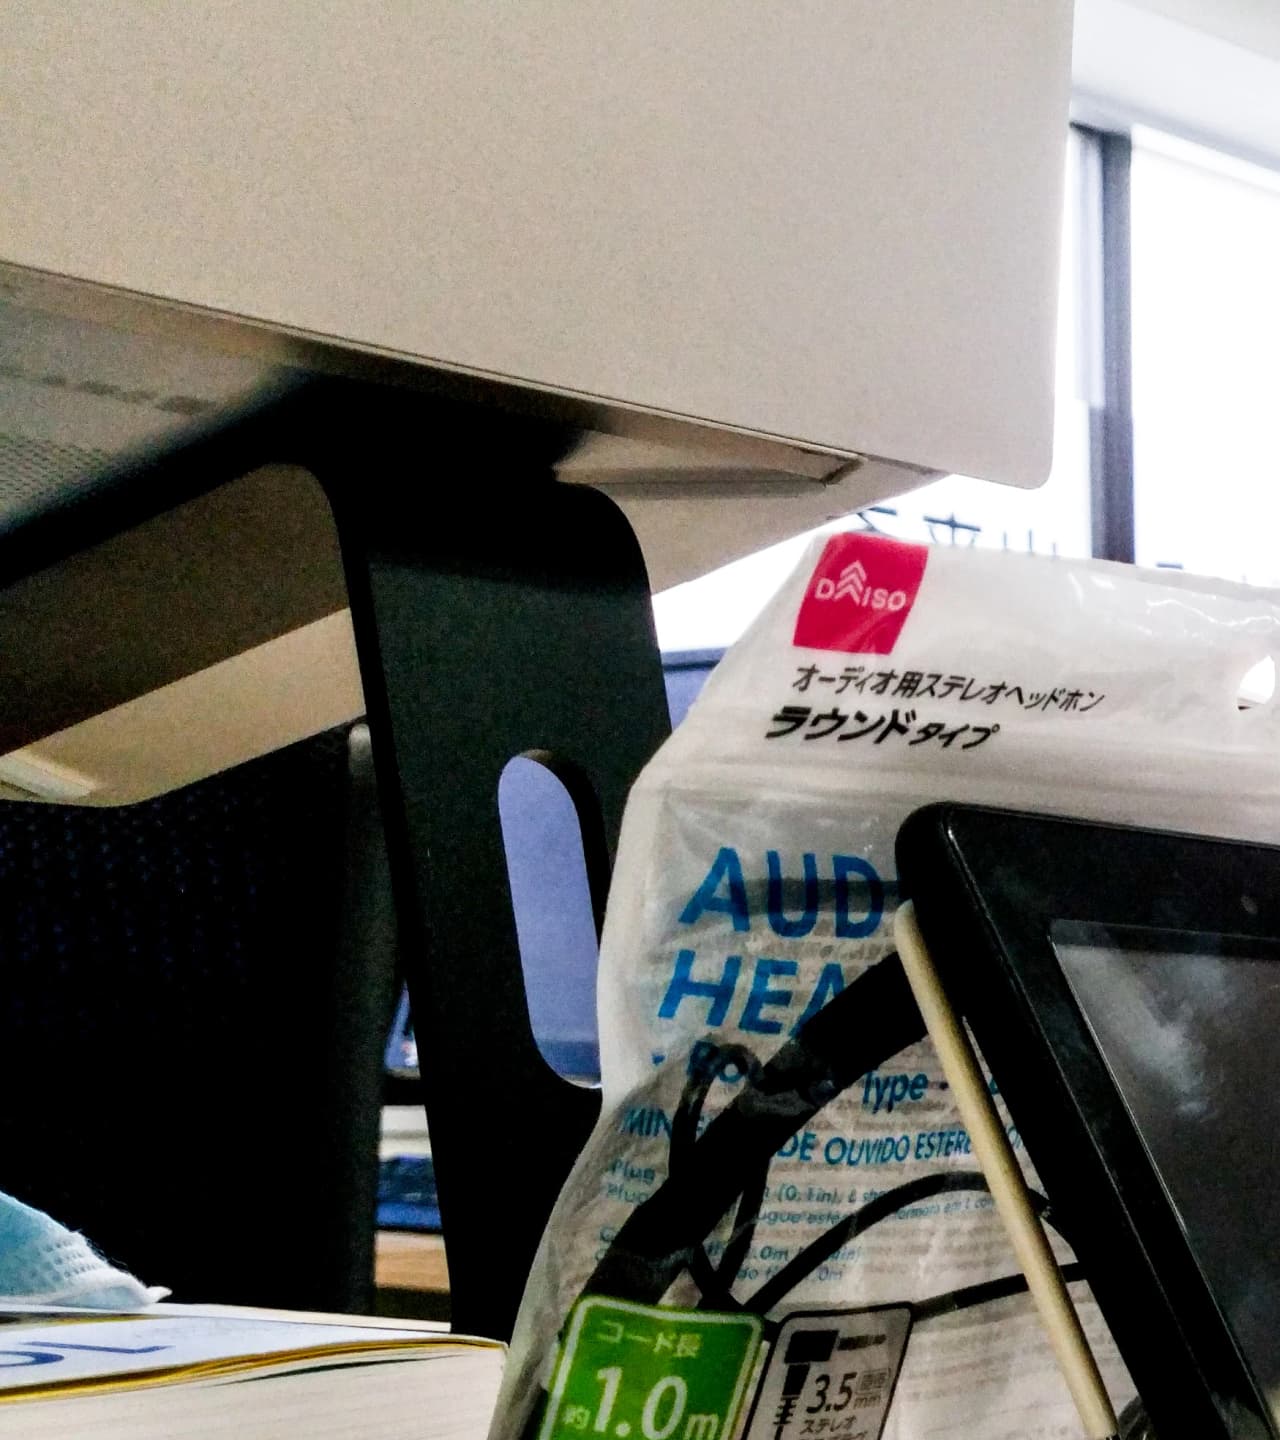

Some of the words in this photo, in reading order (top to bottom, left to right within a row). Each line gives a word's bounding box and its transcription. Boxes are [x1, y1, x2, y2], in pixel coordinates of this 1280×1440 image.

[791, 664, 1105, 713] オーディオ用ステレオヘッドホン
[765, 704, 999, 751] ラウンドタイプ
[677, 846, 898, 940] AUD
[657, 949, 850, 1036] HEA
[618, 1107, 674, 1137] MIN
[824, 1135, 910, 1166] OUVIDO
[806, 1373, 858, 1413] 3.5
[800, 1414, 857, 1435] ステレオ
